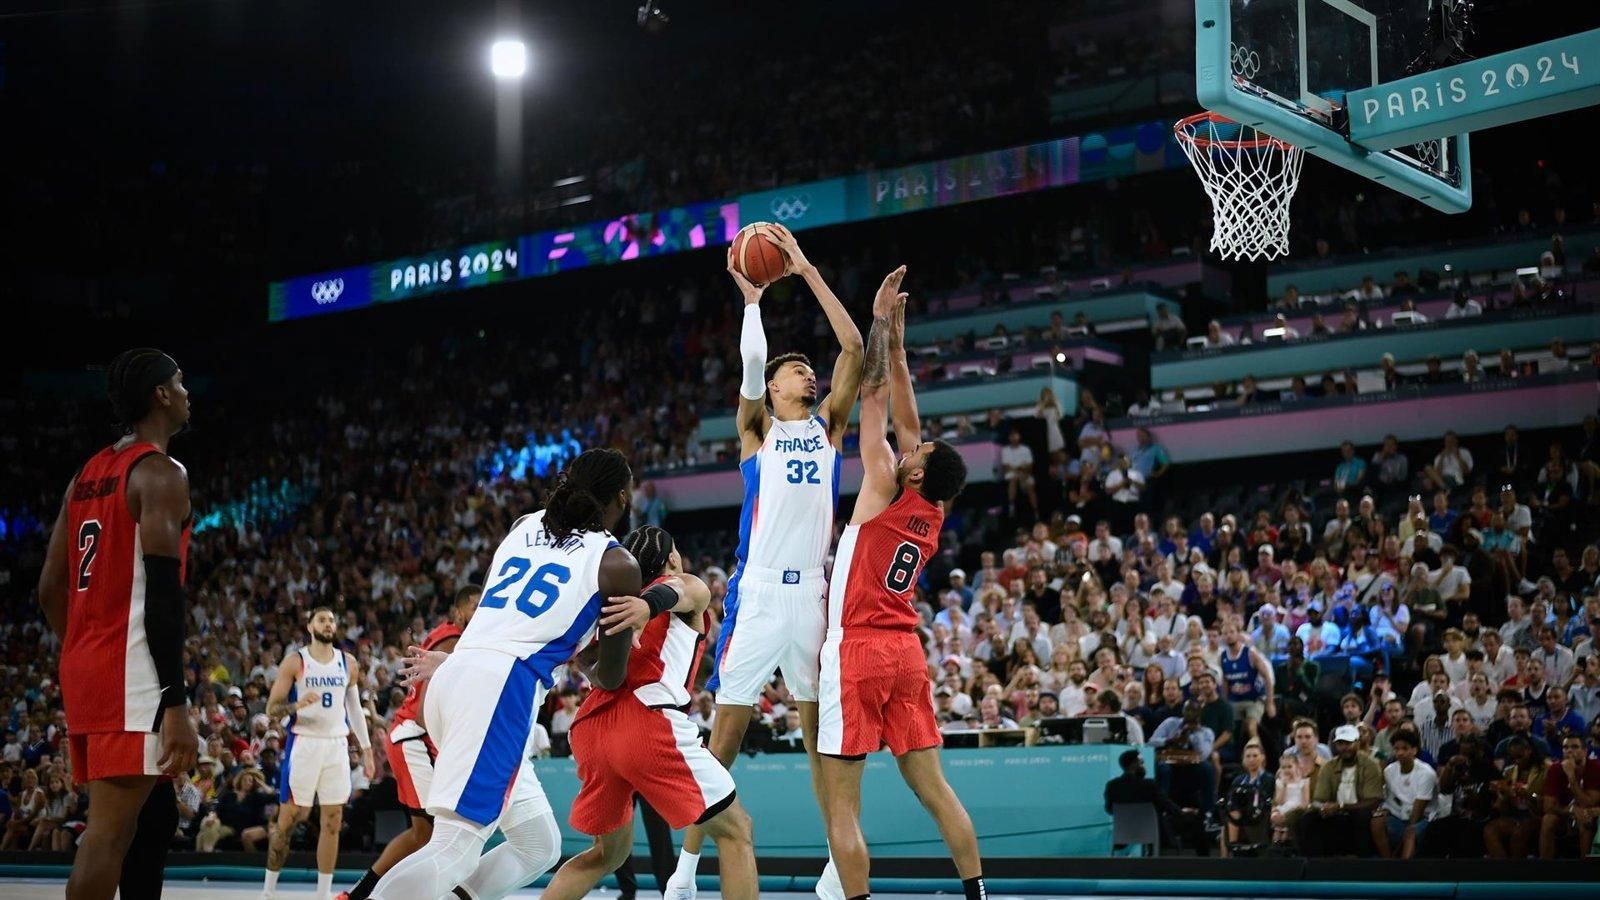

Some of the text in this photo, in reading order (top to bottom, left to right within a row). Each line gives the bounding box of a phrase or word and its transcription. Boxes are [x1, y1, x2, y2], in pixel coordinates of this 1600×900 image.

[1363, 51, 1580, 124] PARIS 2024
[390, 247, 518, 291] PARIS 2024
[775, 434, 825, 453] FRANCE
[786, 459, 821, 484] 32
[77, 519, 102, 592] 2
[885, 541, 922, 594] 8
[479, 556, 572, 619] 26
[305, 676, 346, 688] FRANCE
[322, 692, 333, 708] 8
